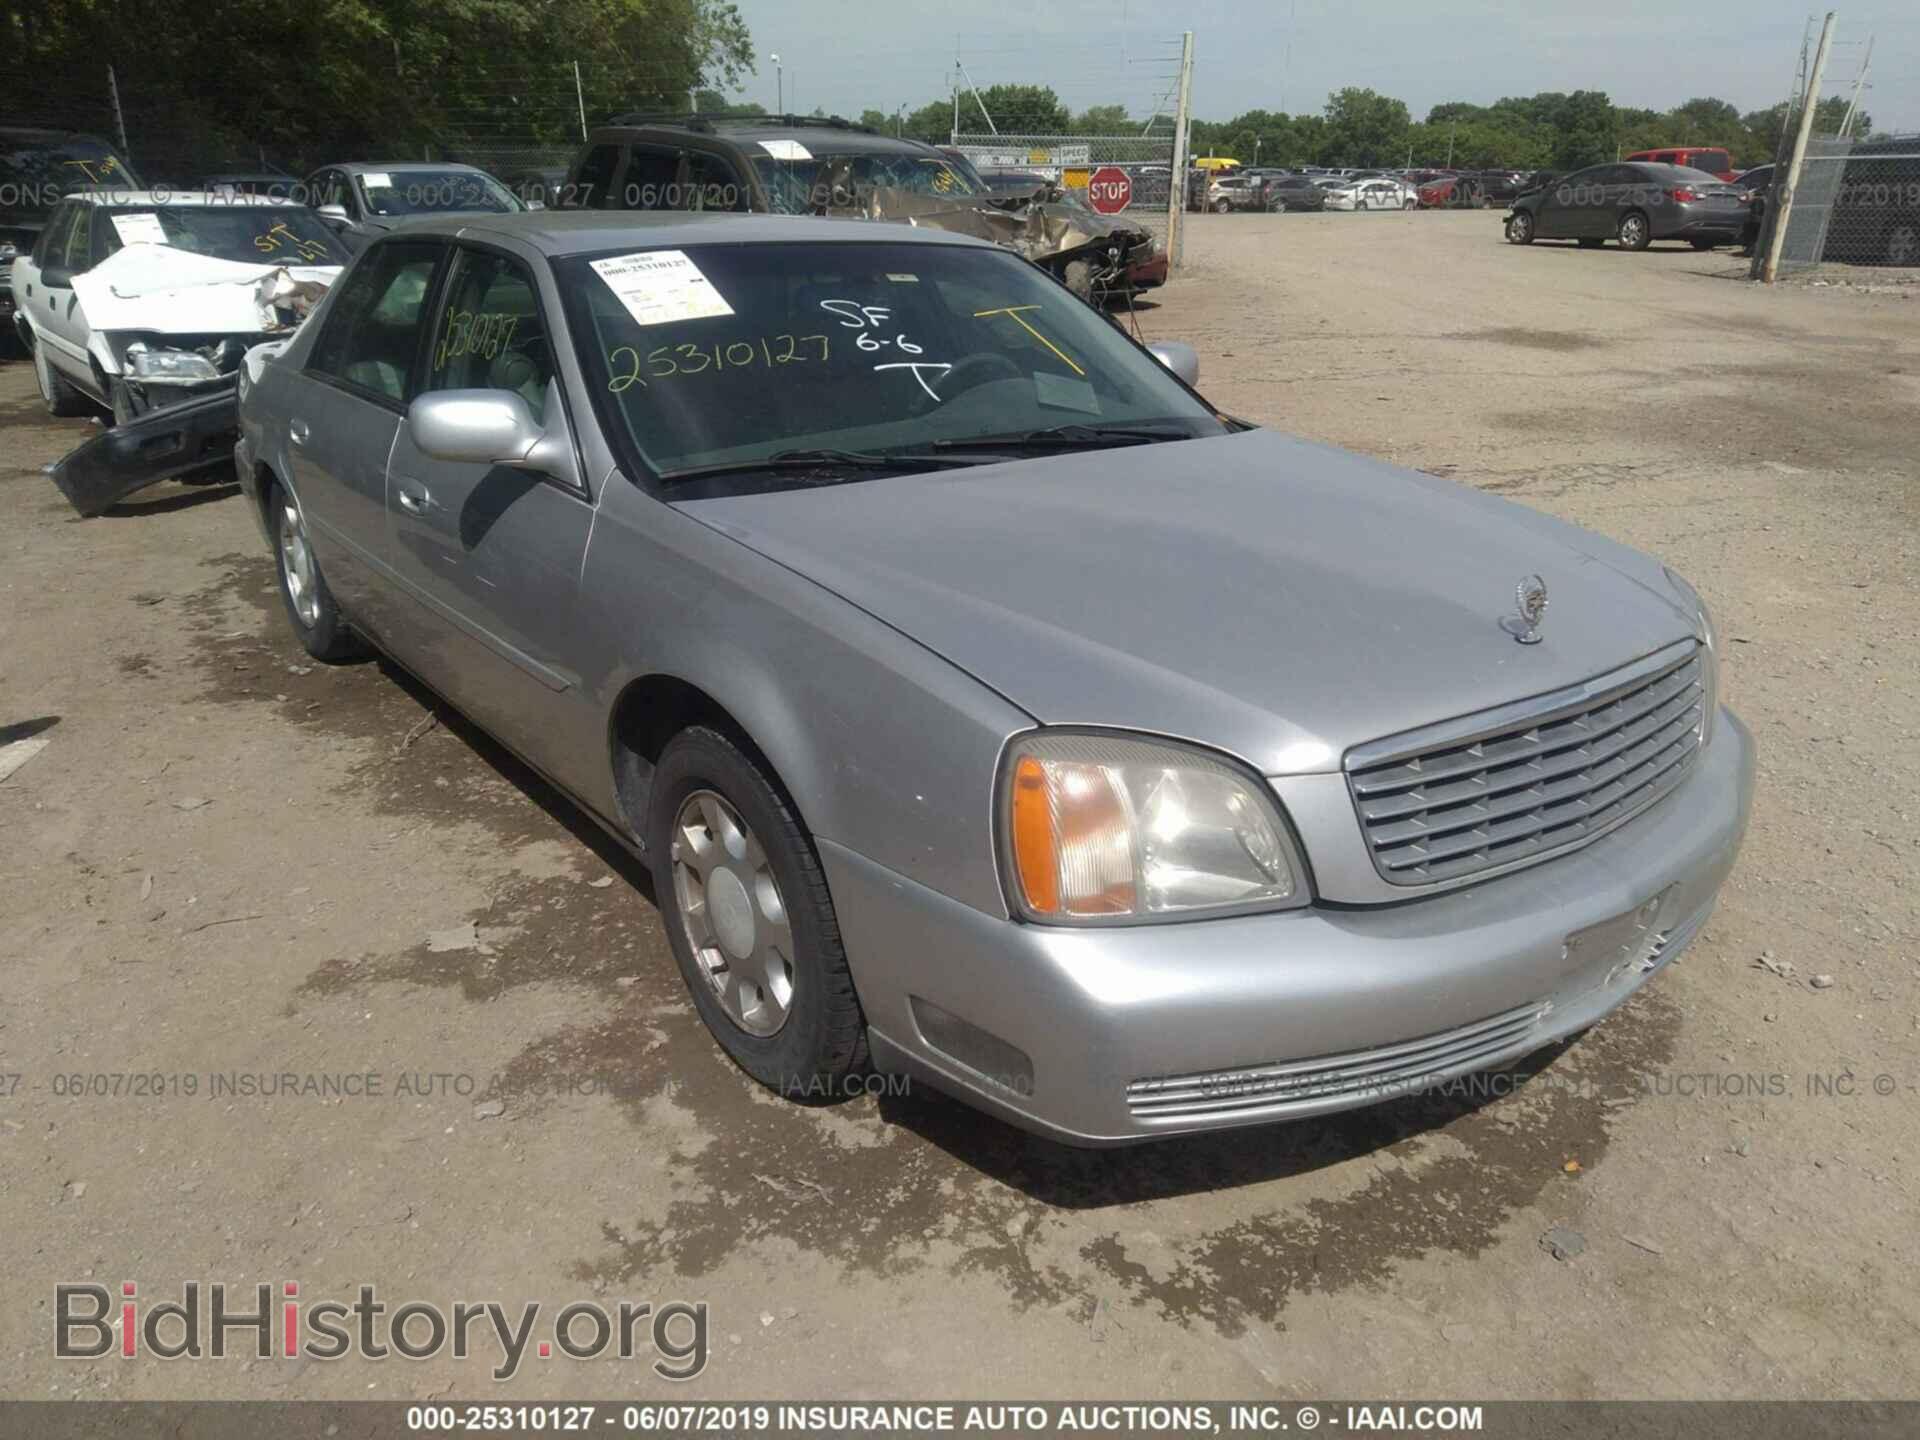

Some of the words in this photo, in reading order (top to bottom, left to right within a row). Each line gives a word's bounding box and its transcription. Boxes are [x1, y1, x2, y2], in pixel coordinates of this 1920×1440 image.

[1090, 182, 1130, 200] STOP
[819, 299, 891, 329] SF
[855, 333, 924, 354] 6-6
[607, 334, 829, 393] 25310127
